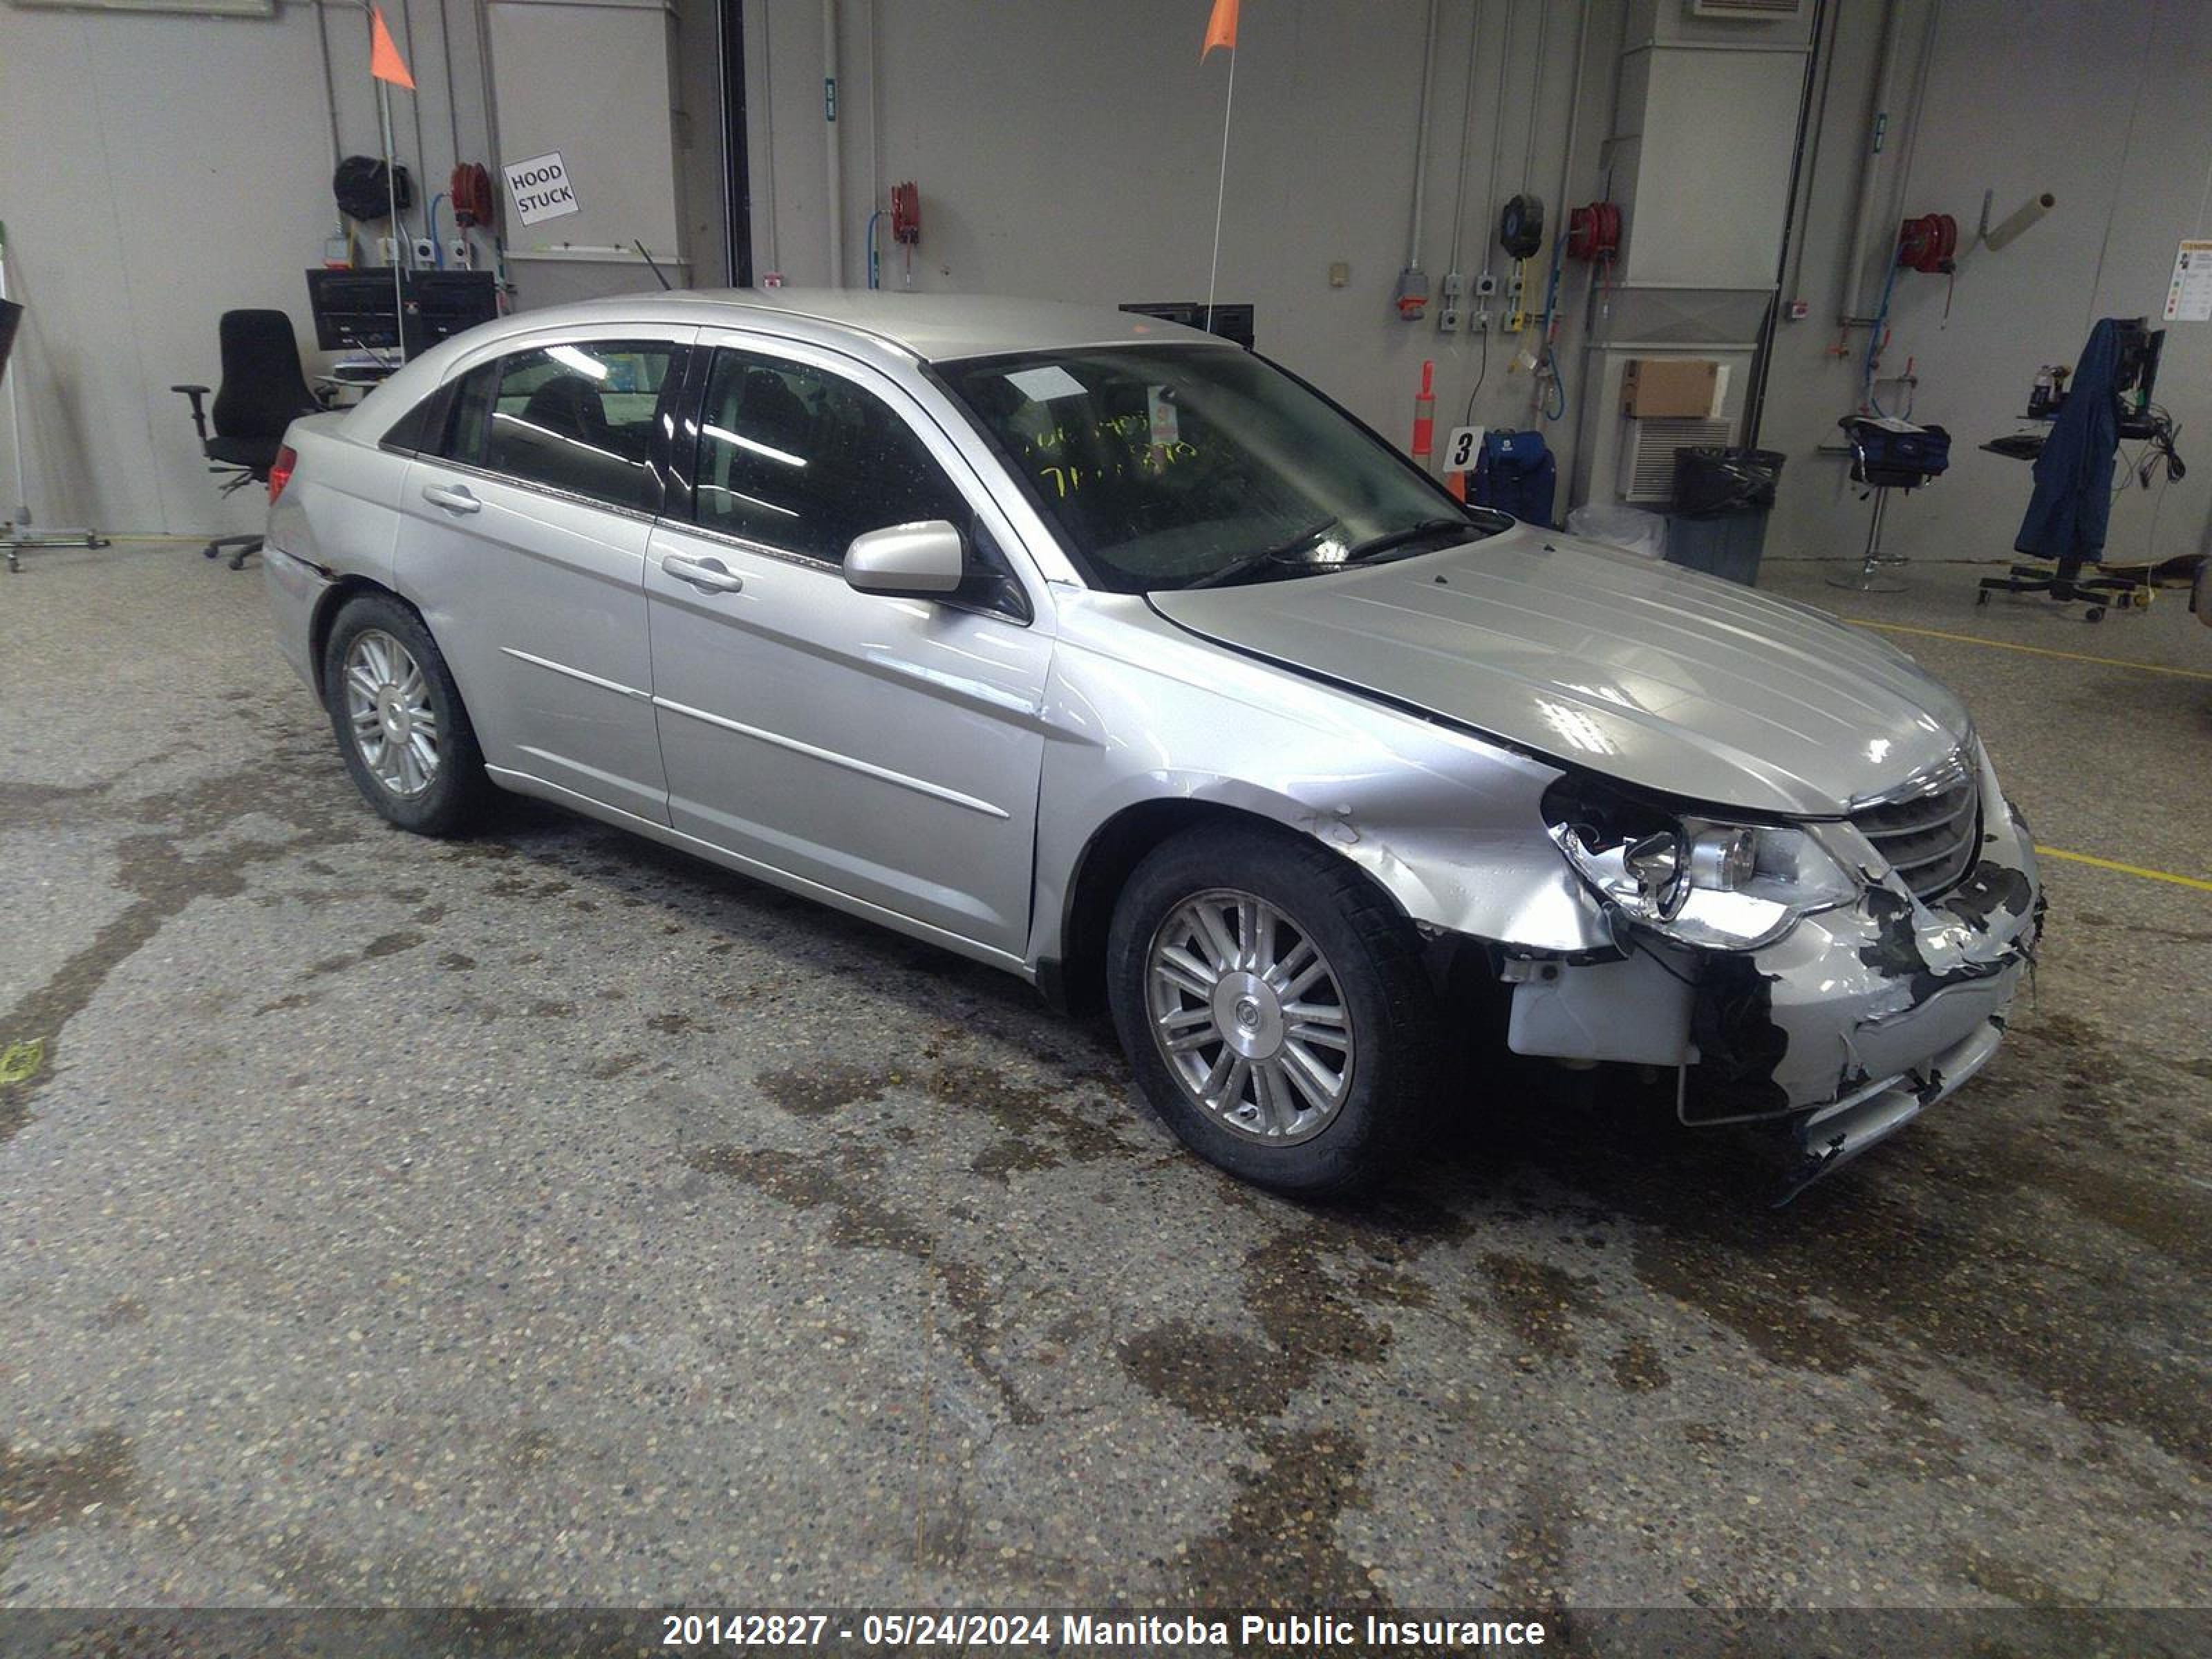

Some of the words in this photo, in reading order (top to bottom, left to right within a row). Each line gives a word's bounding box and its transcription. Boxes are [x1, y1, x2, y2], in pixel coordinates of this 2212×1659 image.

[512, 165, 562, 190] HOOD
[518, 186, 572, 213] STUCK
[1454, 432, 1473, 465] 3
